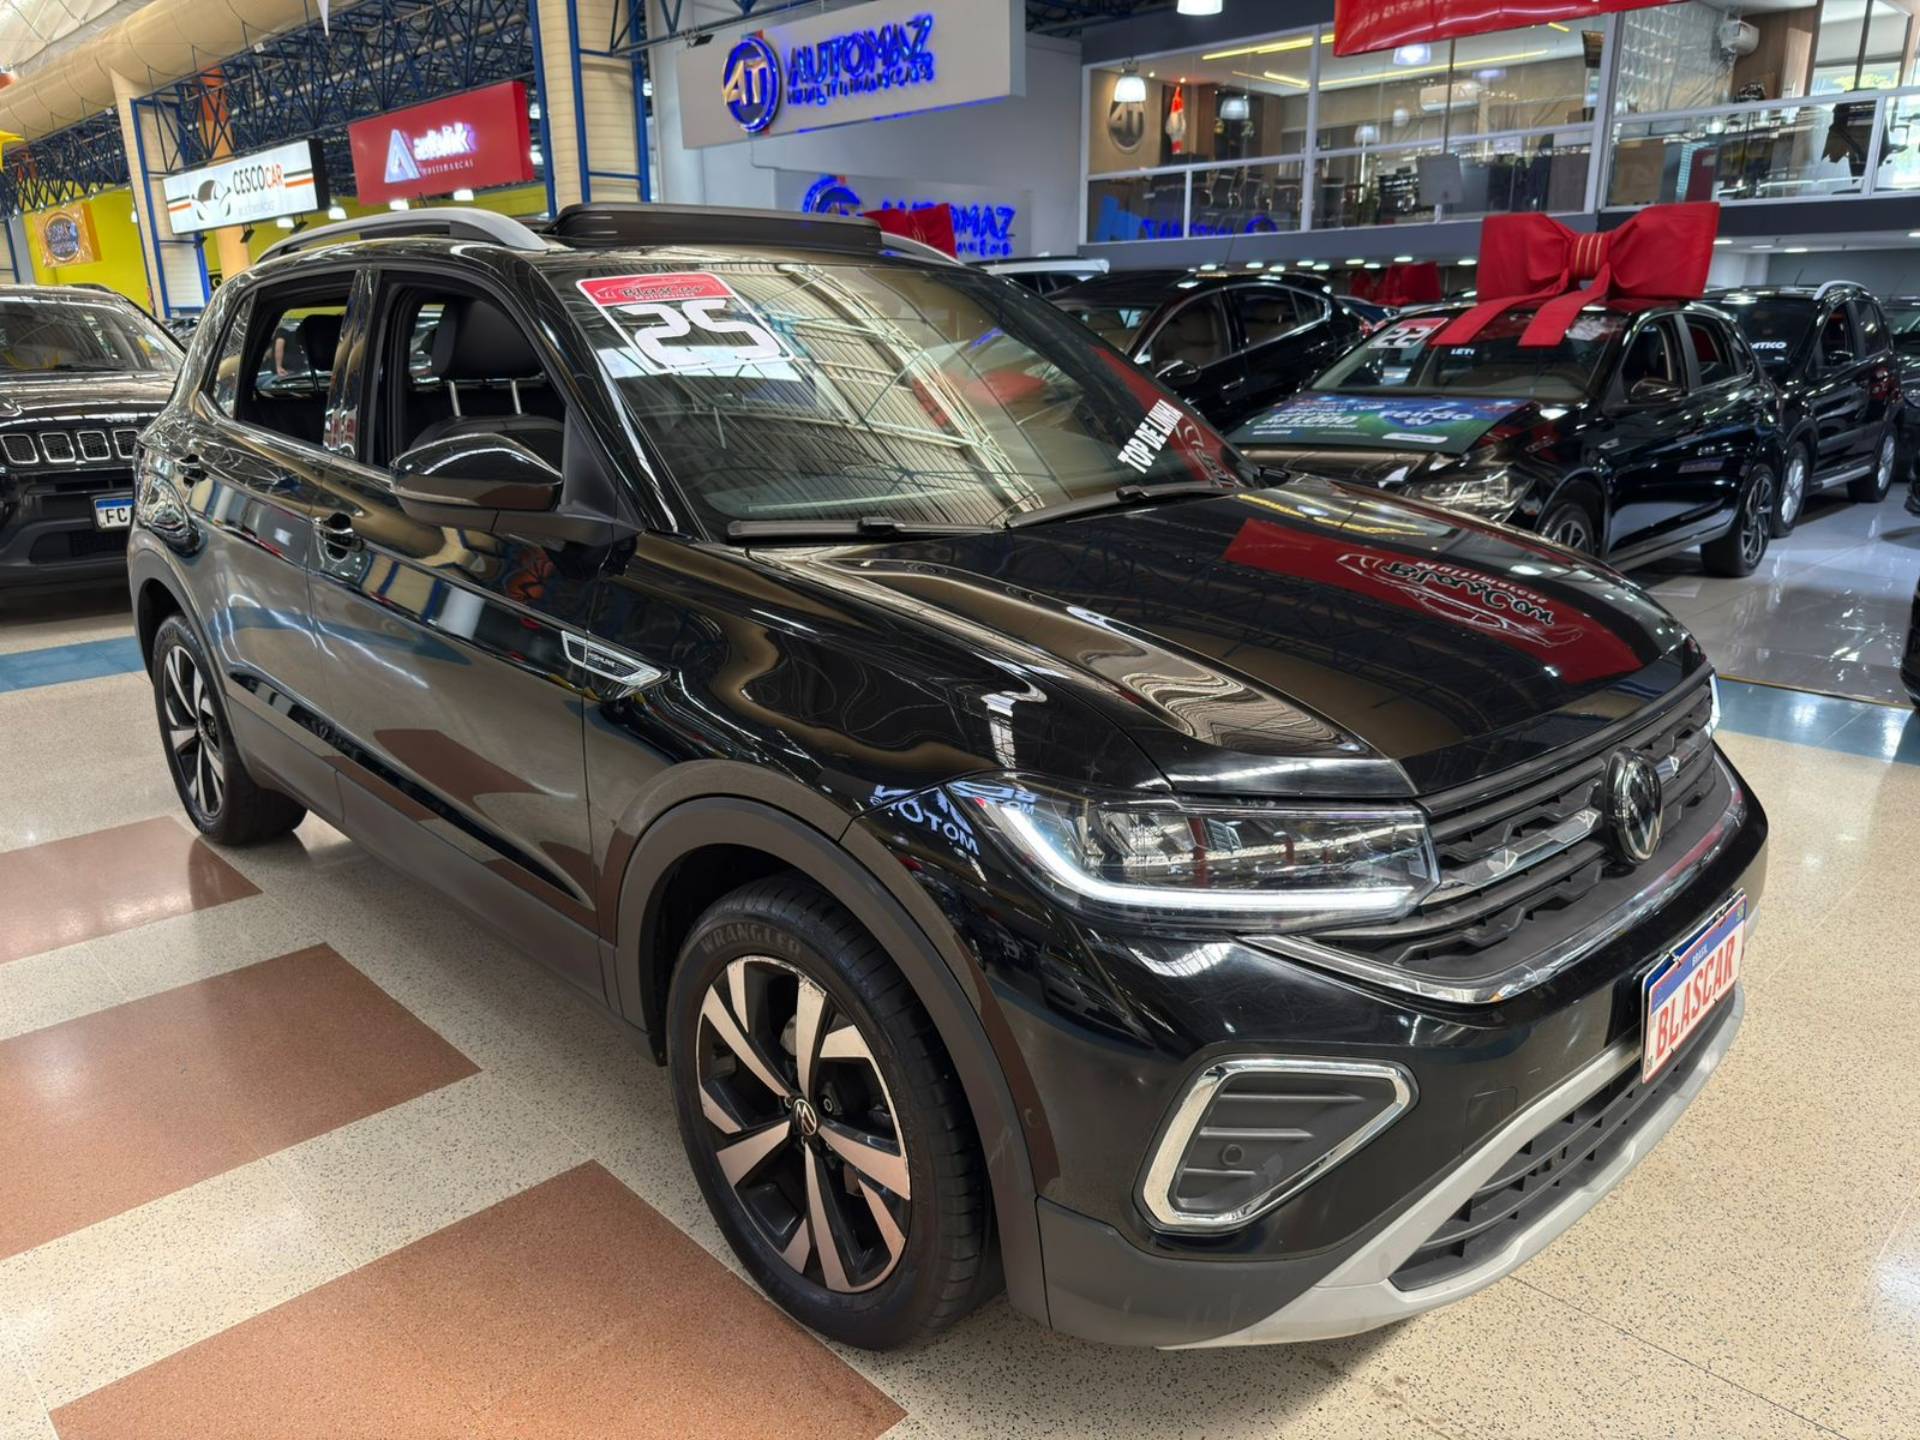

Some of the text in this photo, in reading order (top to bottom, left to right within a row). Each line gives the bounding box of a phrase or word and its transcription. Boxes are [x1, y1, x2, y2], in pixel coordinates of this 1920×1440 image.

[787, 13, 934, 87] AUTOMAZ
[617, 298, 782, 366] 25
[1375, 328, 1432, 347] 22
[1117, 437, 1157, 475] TOP
[1134, 421, 1168, 452] DE
[1656, 935, 1737, 1062] BLASCAR
